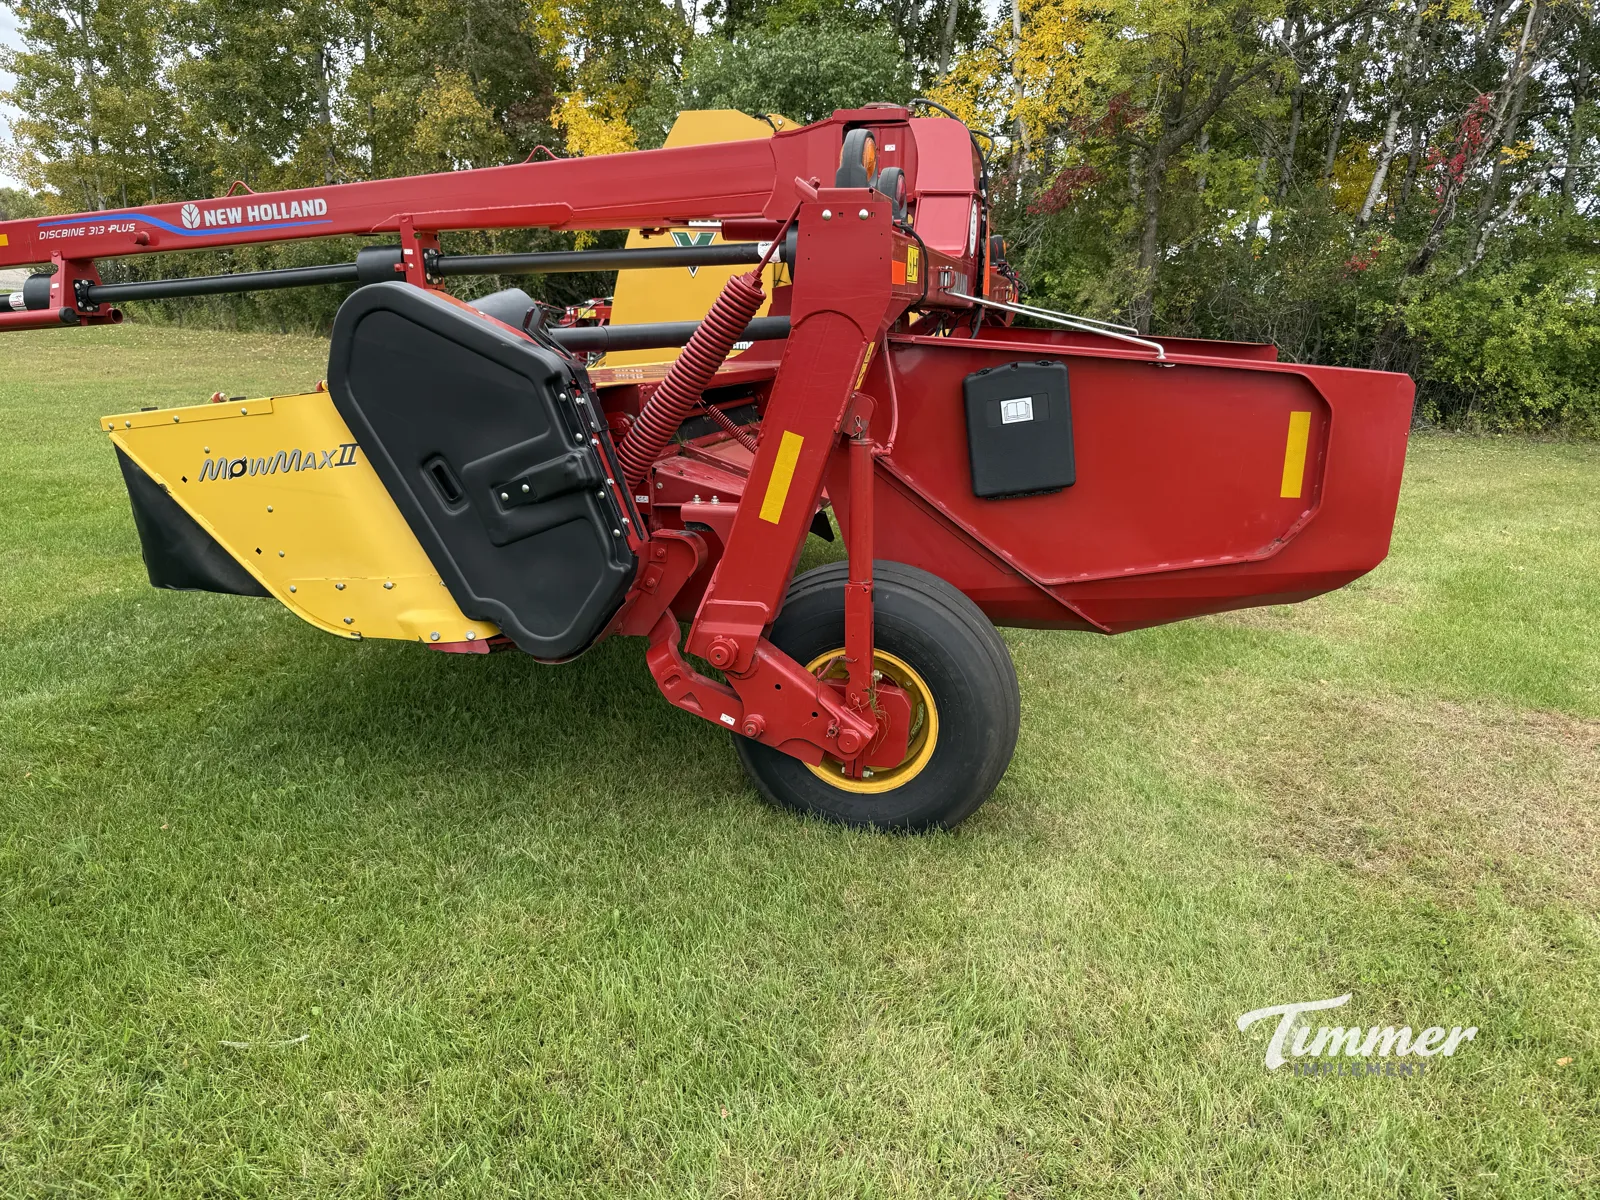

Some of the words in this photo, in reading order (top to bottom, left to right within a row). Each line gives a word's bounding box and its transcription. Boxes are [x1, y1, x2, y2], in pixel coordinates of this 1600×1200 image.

[204, 207, 242, 226] NEW
[247, 198, 328, 222] HOLLAND
[39, 227, 85, 240] DISCBINE
[88, 225, 105, 236] 313
